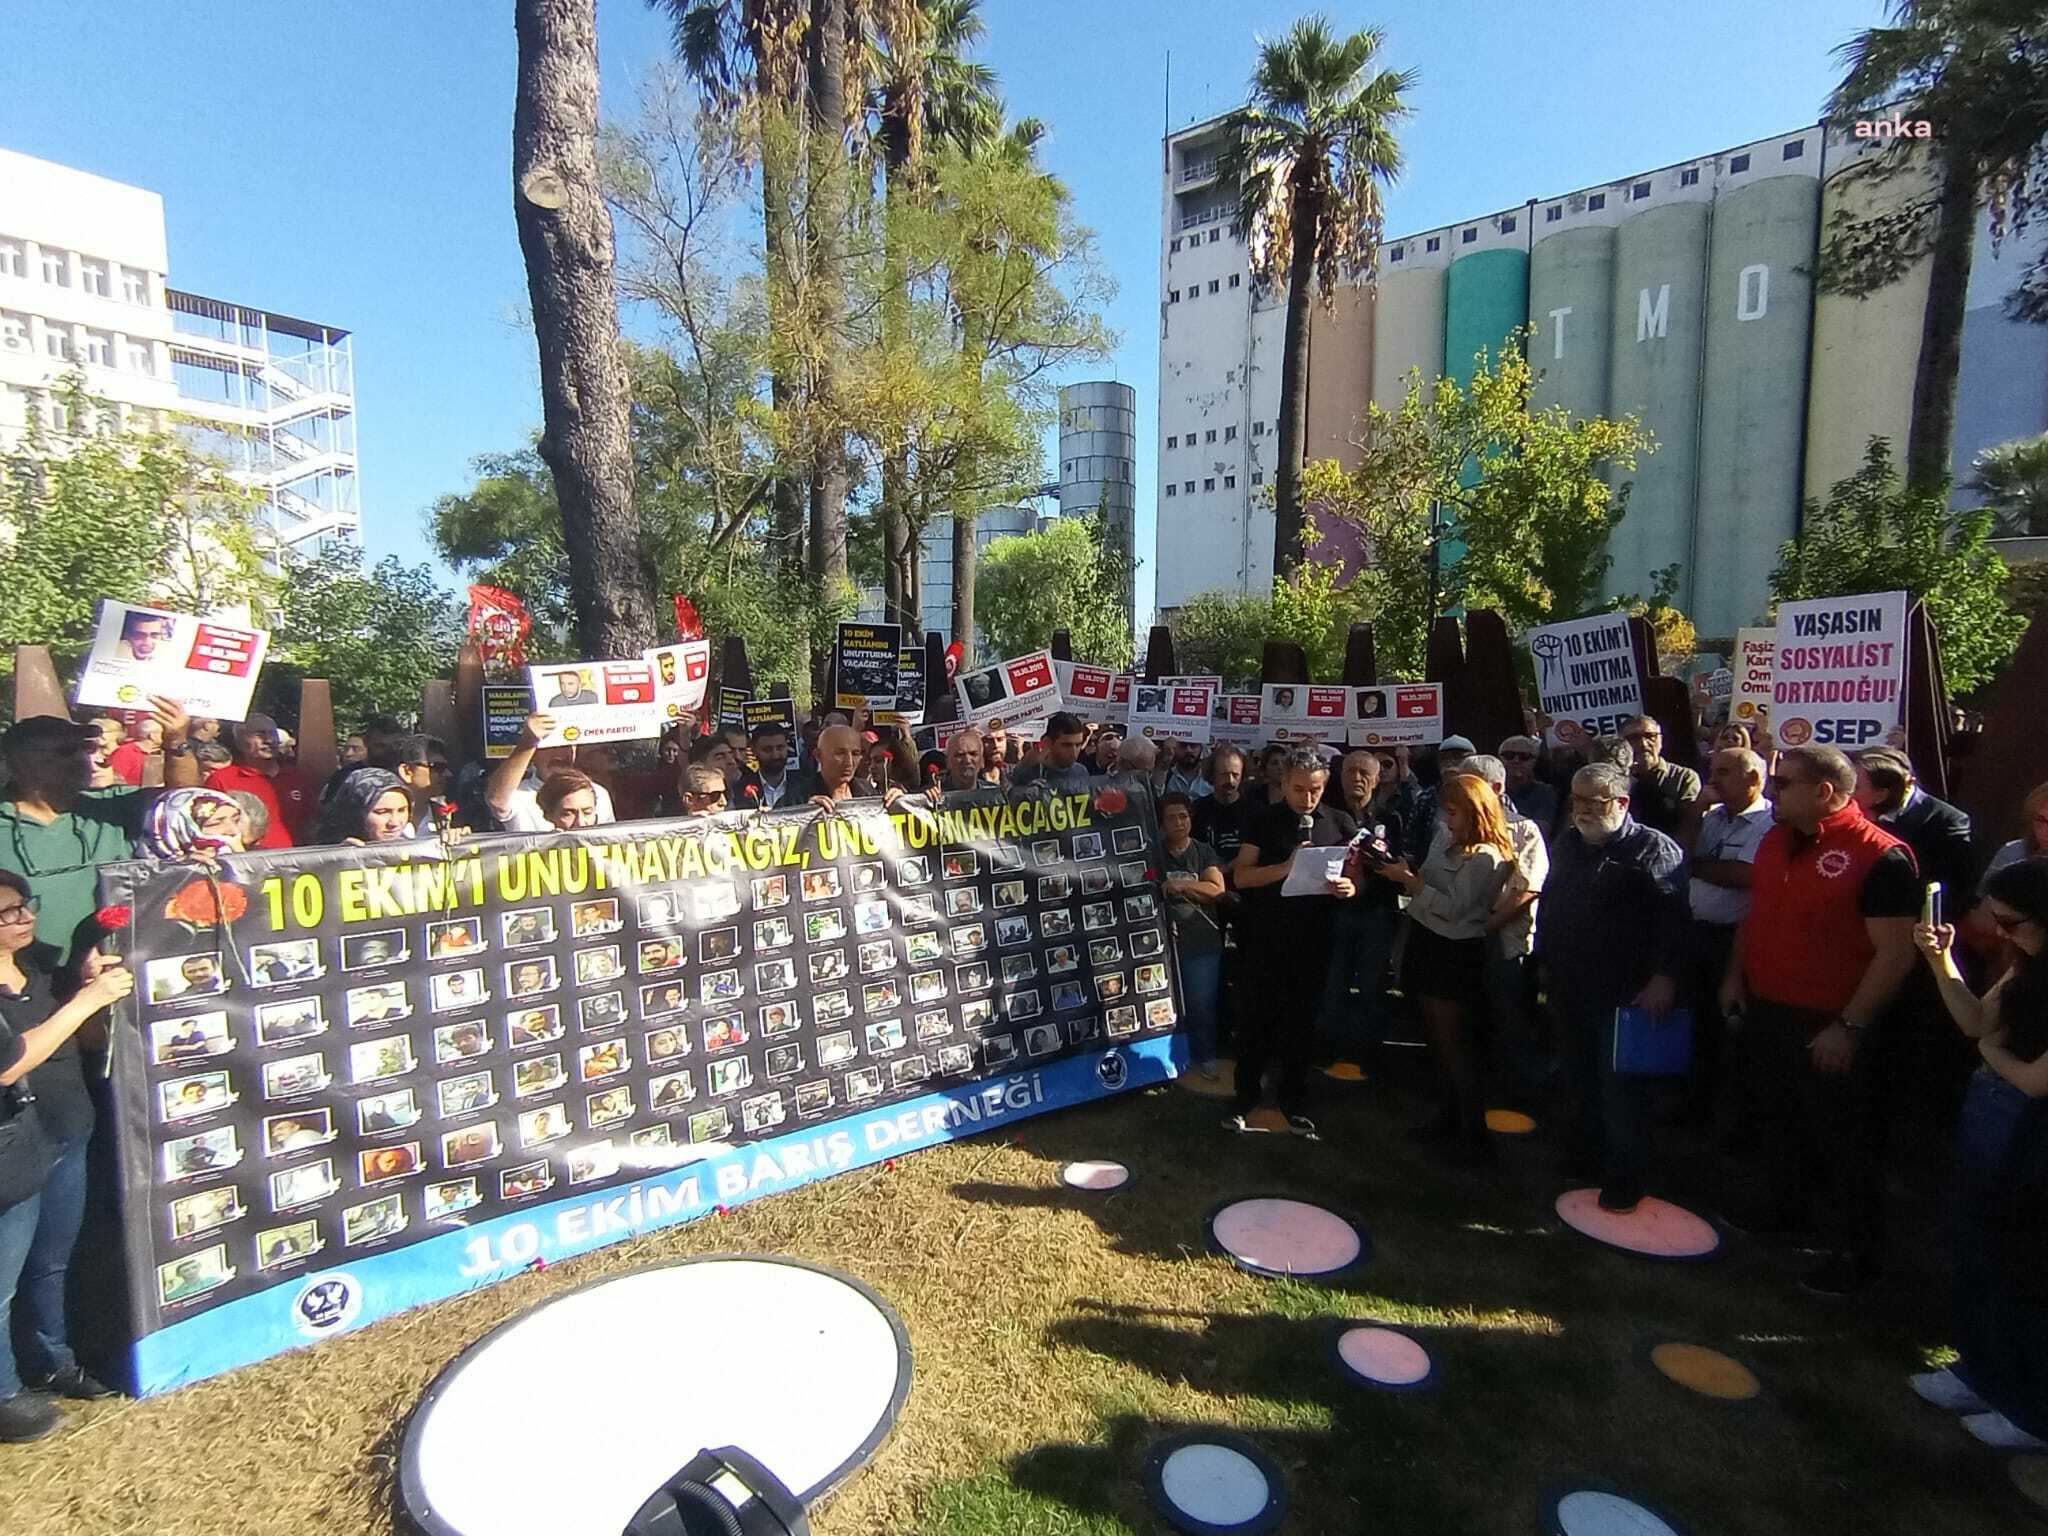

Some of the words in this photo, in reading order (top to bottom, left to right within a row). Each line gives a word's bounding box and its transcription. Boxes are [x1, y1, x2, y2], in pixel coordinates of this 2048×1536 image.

[1793, 607, 1882, 640] YAŞASIN
[1563, 634, 1582, 658] 10
[1583, 621, 1630, 655] EKİM'İ
[1743, 641, 1775, 656] Faşiz
[1570, 655, 1633, 687] UNUTMA
[1780, 641, 1894, 671] SOSYALİST
[1748, 669, 1771, 681] Om
[1774, 675, 1897, 704] ORTADOĞU!
[1542, 683, 1638, 714] UNUTTURMA!
[1814, 718, 1882, 745] SEP
[260, 873, 324, 932] 10
[339, 846, 486, 925] EKİM'İ
[497, 824, 810, 898] UNUTMAYACAĞIZ,
[461, 1222, 541, 1278] 10
[556, 1175, 700, 1246] EKİM
[716, 1130, 855, 1200] BARIŞ
[865, 1071, 1043, 1152] DERNEĞİ
